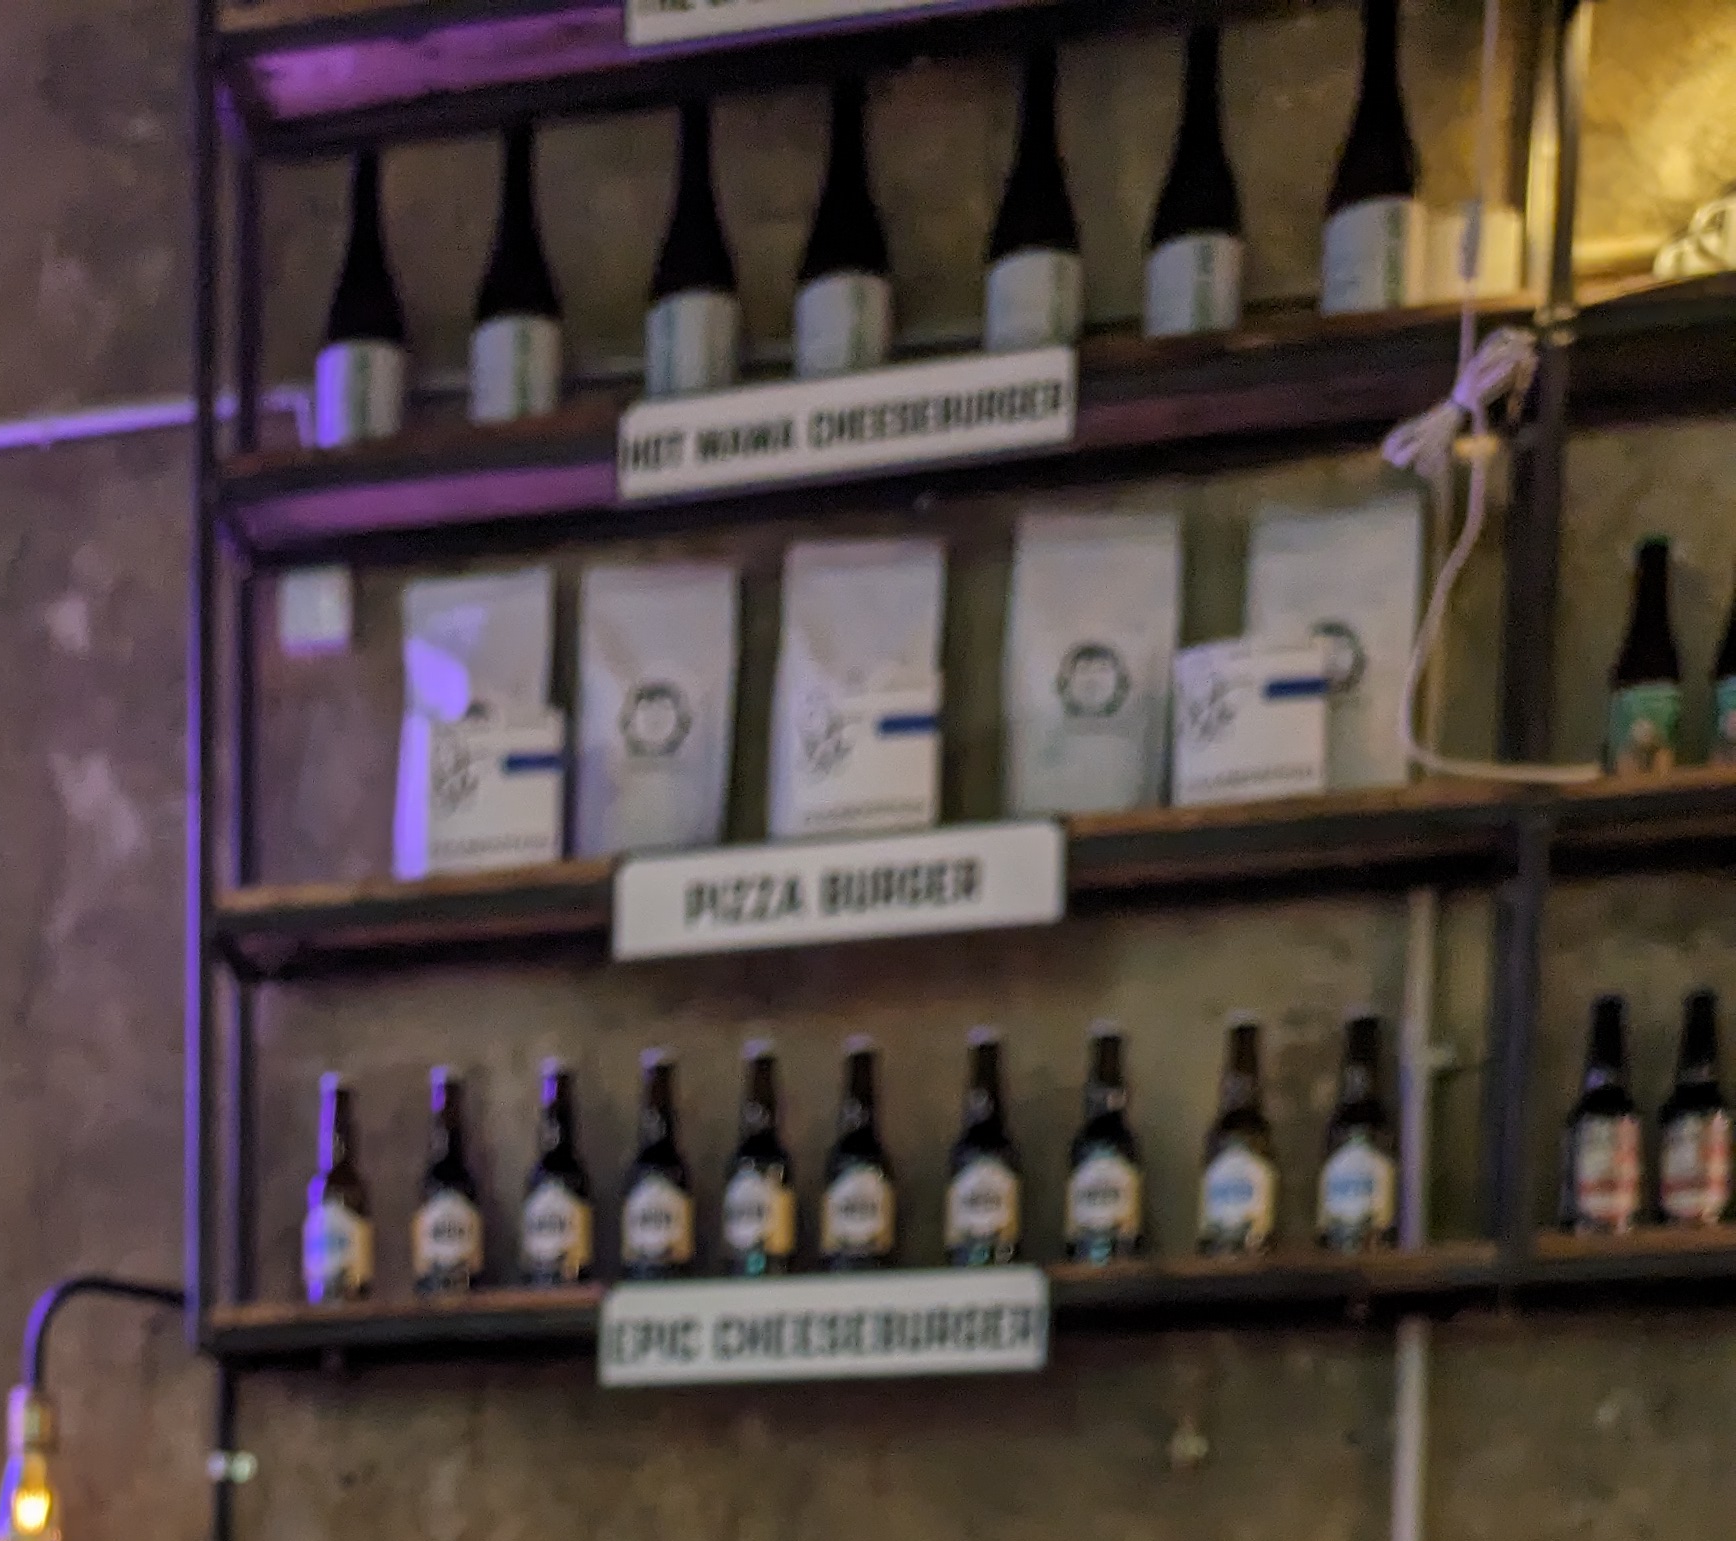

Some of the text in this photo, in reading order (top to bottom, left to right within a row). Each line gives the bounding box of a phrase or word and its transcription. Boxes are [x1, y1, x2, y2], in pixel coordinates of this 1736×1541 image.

[807, 378, 1064, 449] CHEESEBURGER
[684, 860, 981, 926] PIZZA BURGER
[605, 1305, 1038, 1363] EPIC CHEESEBURGER
